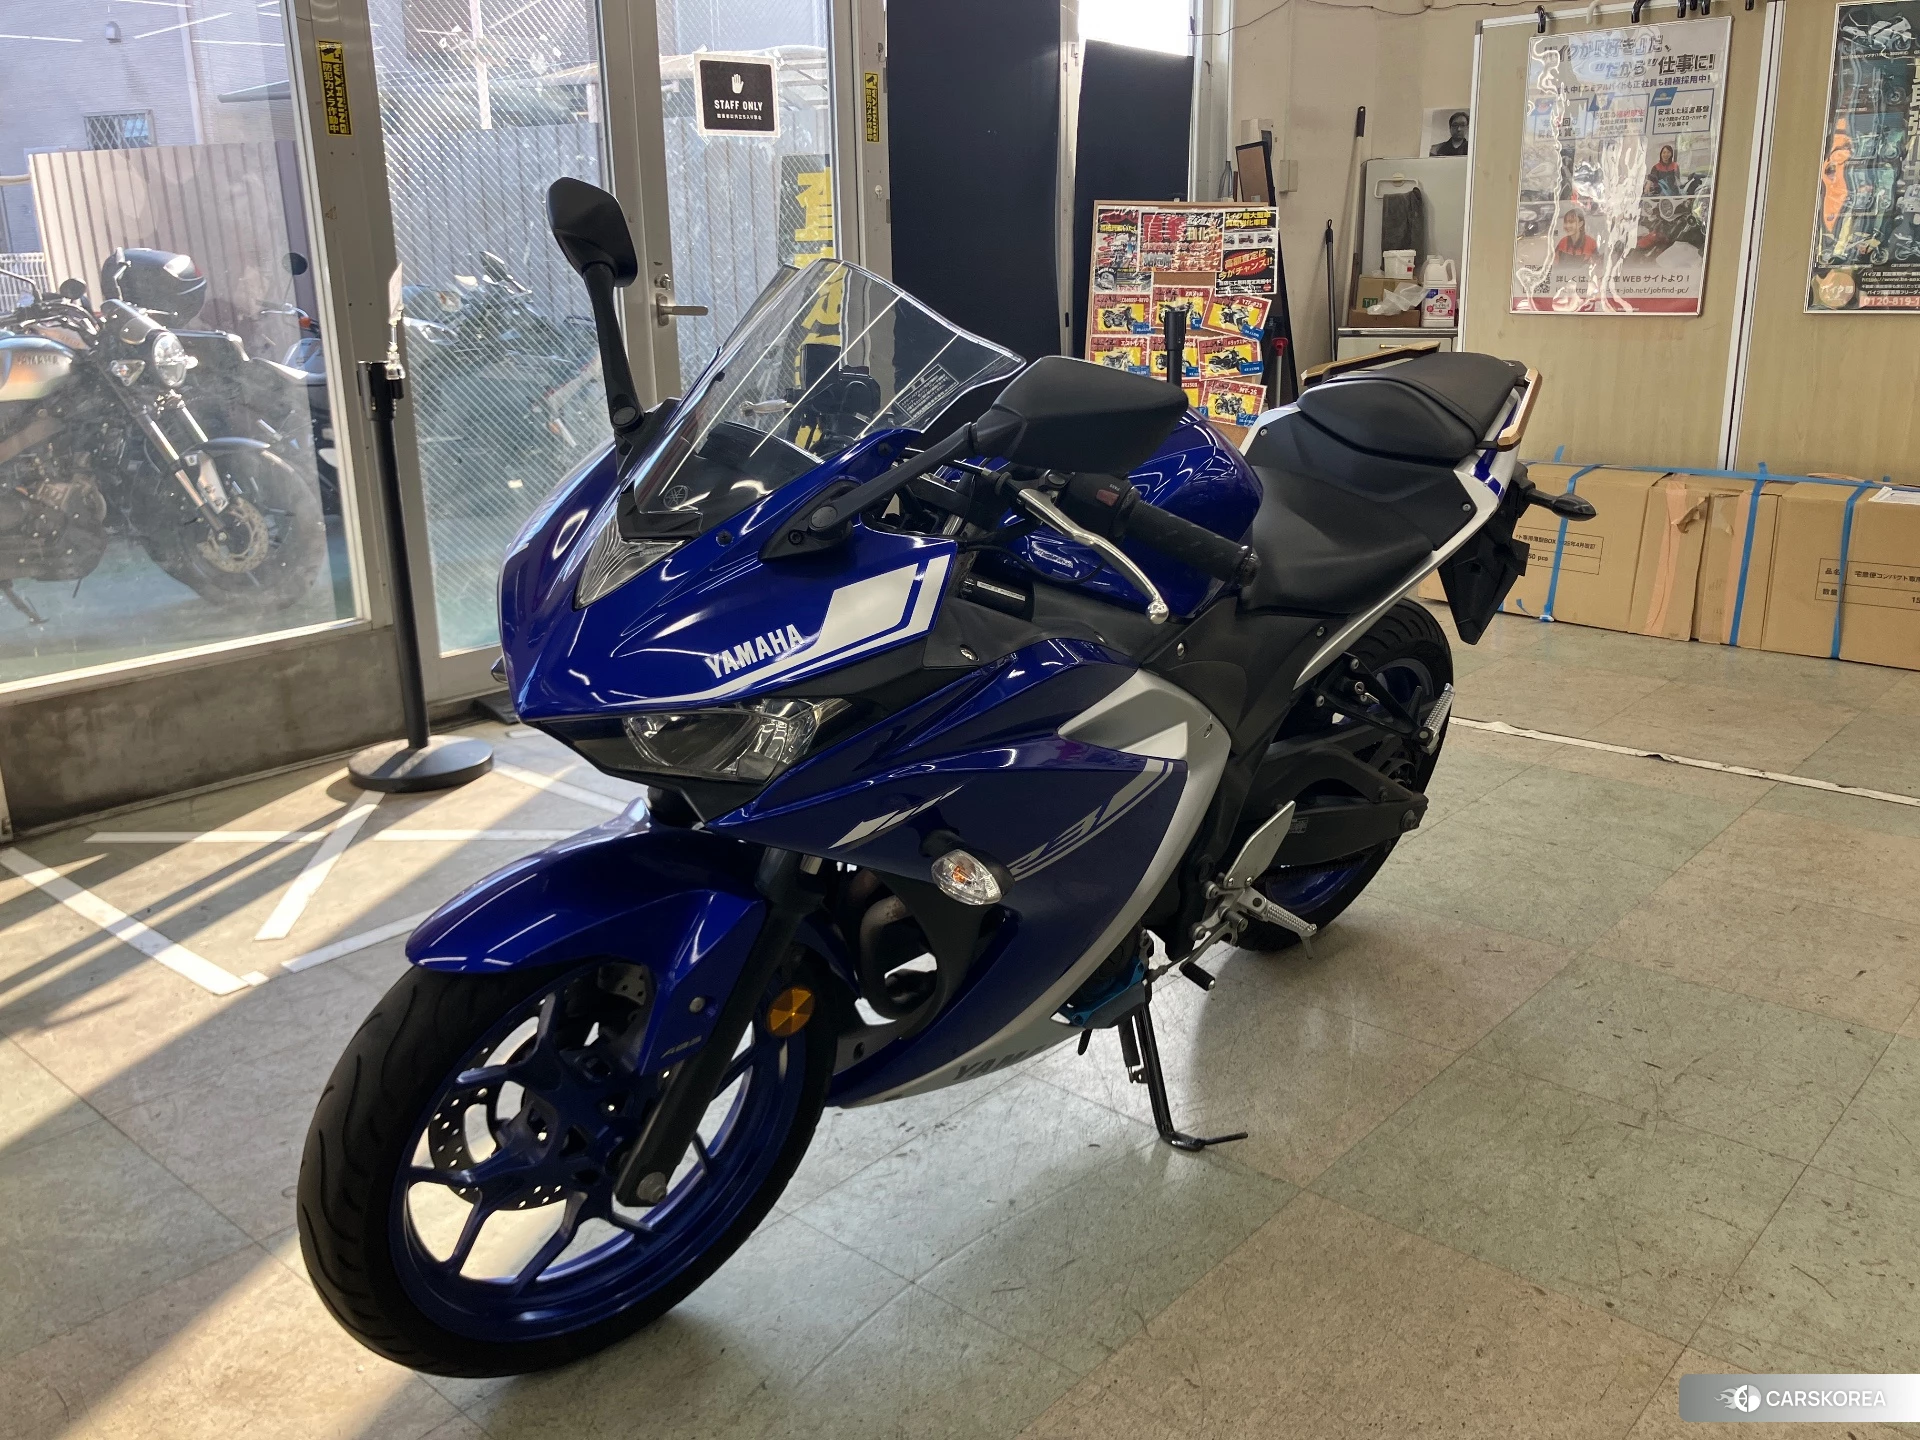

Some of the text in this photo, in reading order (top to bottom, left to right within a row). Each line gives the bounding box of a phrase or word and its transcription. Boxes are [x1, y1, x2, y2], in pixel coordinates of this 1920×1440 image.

[322, 62, 339, 133] 防犯カメラ作動中
[333, 63, 347, 134] WARNING
[714, 99, 763, 111] STAFF ONLY
[1825, 568, 1840, 576] 品名
[703, 624, 805, 679] YAMAHA
